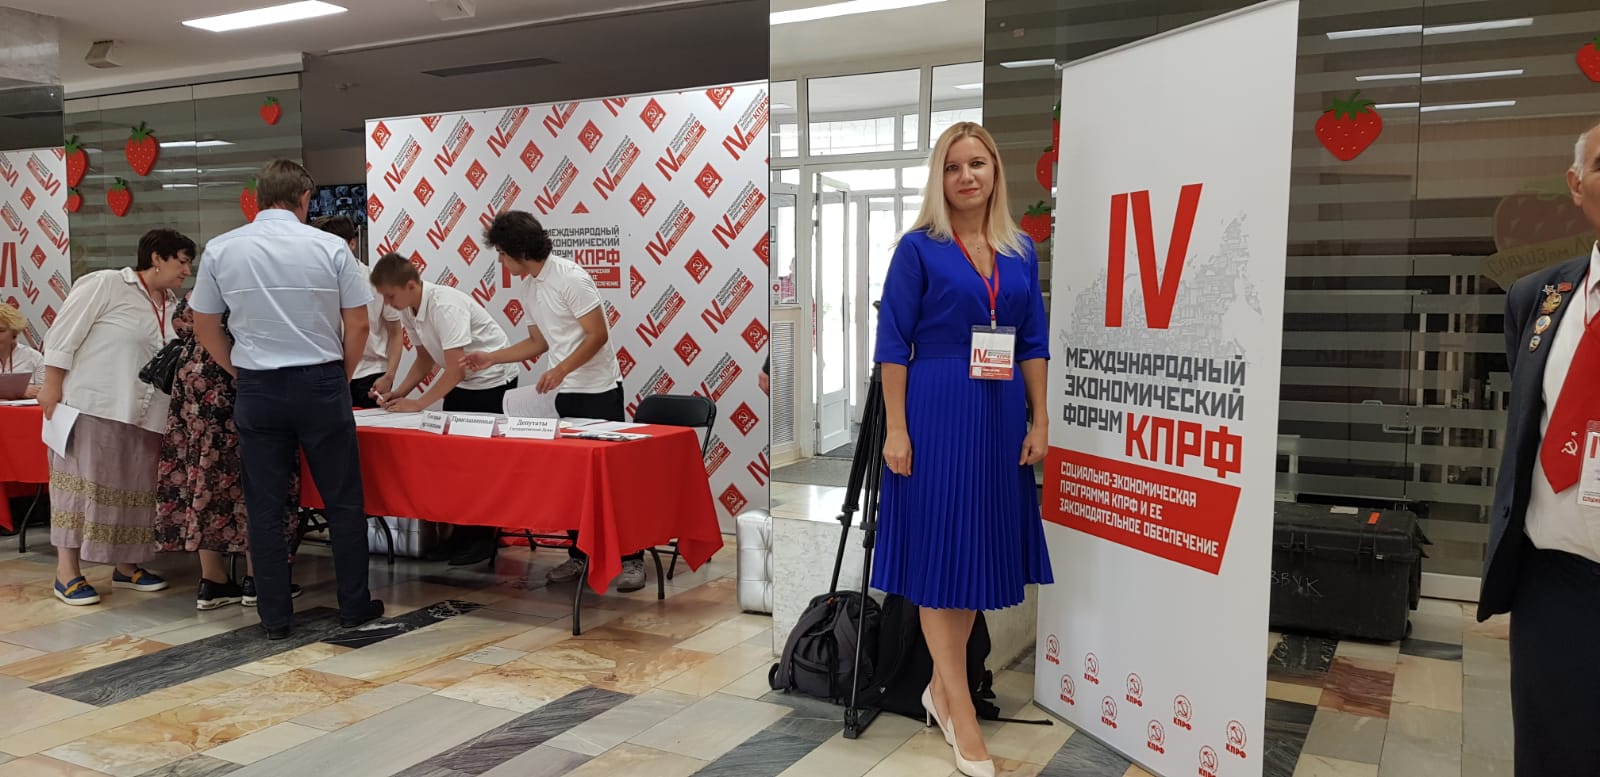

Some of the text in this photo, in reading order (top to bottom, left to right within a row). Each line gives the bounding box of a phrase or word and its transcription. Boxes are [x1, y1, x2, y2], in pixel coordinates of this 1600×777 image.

[552, 236, 620, 247] КОНОМИЧЕСКИЙ
[552, 248, 620, 265] ОРУМ КПРФ
[1105, 183, 1203, 329] IV
[1066, 347, 1246, 386] МЕЖДУНАРОДНЫЙ
[1065, 374, 1244, 421] ЭКОНОМИЧЕСКИЙ
[1063, 402, 1242, 479] ФОРУМ КПРФ
[1060, 461, 1197, 508] СОЦИАЛЬНО-ЭКОНОМИЧЕСКАЯ
[1060, 480, 1162, 520] ПРОГРАММА КПРФ И ЕЕ
[1059, 498, 1219, 558] ЗАКОНОДАТЕЛЬНОЕ ОБЕСПЕЧЕНИЕ
[1046, 654, 1060, 665] КПРФ
[1084, 673, 1099, 685] КПРФ
[1060, 694, 1075, 705] КПРФ
[1126, 694, 1142, 707] КПРФ
[1101, 716, 1117, 729] КПРФ
[1173, 717, 1192, 731] КПРФ
[1147, 741, 1165, 754] КПРФ
[1226, 743, 1246, 758] КПРФ
